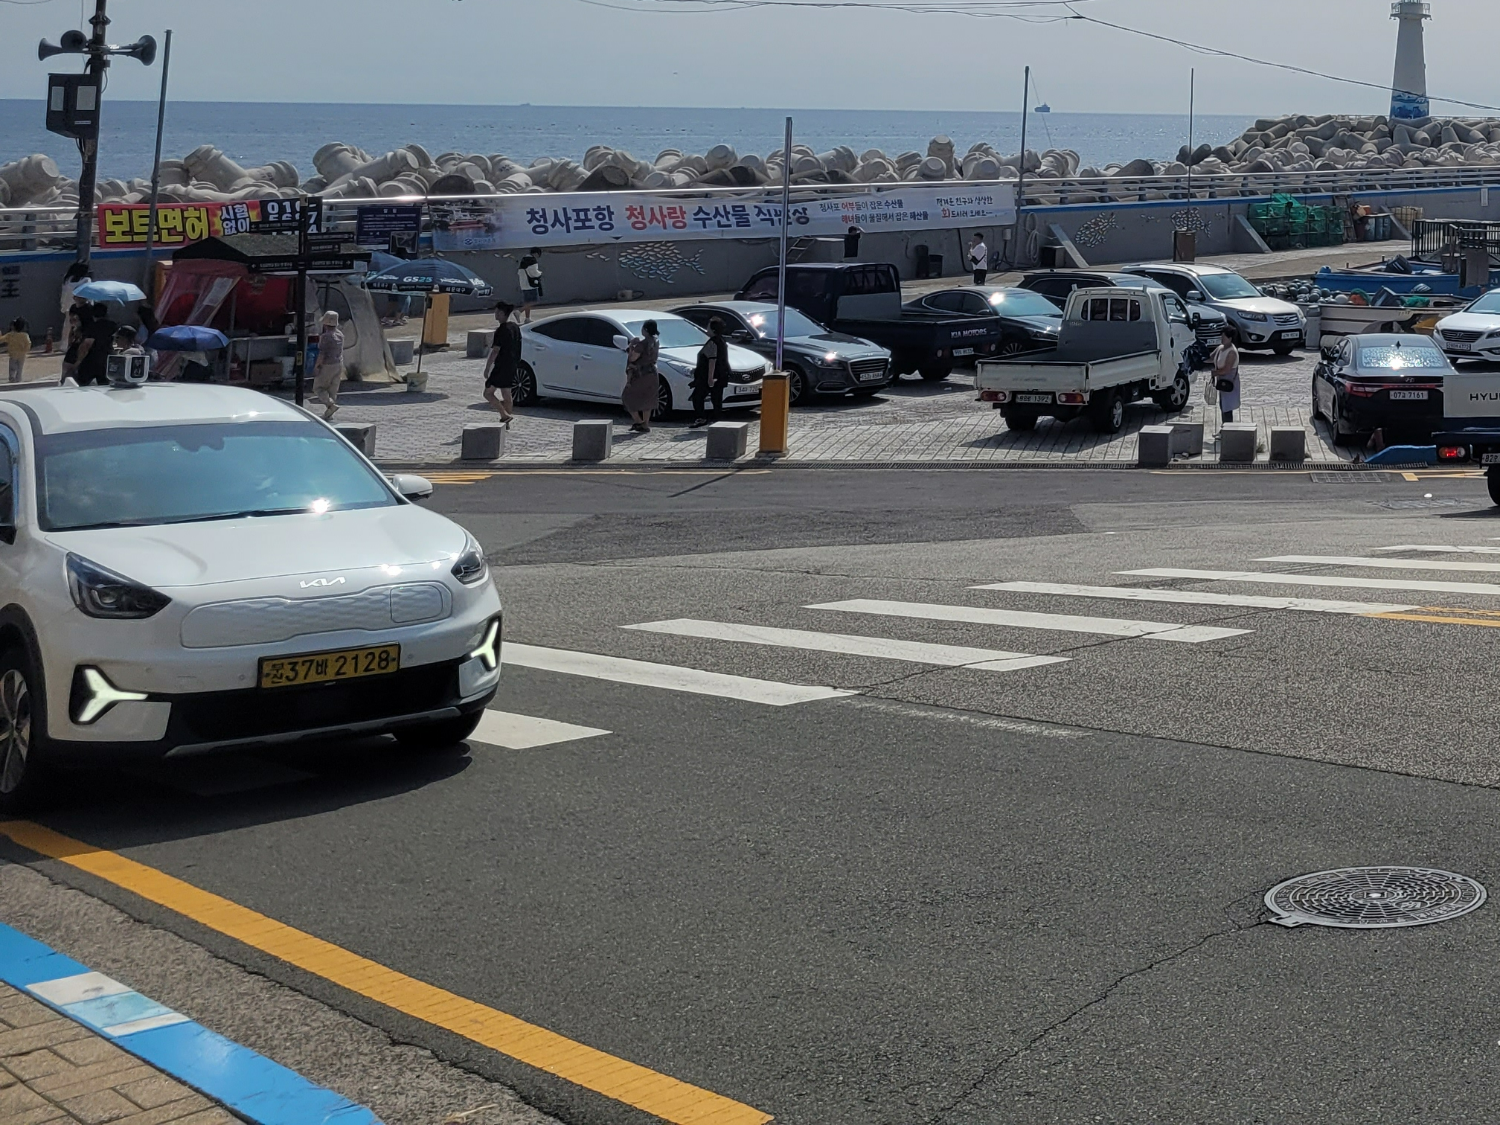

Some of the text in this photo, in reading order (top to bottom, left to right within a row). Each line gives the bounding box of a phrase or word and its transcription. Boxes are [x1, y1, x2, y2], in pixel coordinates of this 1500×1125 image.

[219, 202, 249, 220] 시험
[526, 204, 615, 234] 청사포항
[625, 204, 687, 231] 청사랑
[692, 204, 751, 229] 수산물
[941, 208, 950, 218] 회
[103, 205, 210, 243] 보트면허
[221, 218, 250, 236] 없이
[950, 327, 987, 339] KIA MOTORS
[1408, 391, 1424, 399] 7161
[334, 649, 391, 677] 2128
